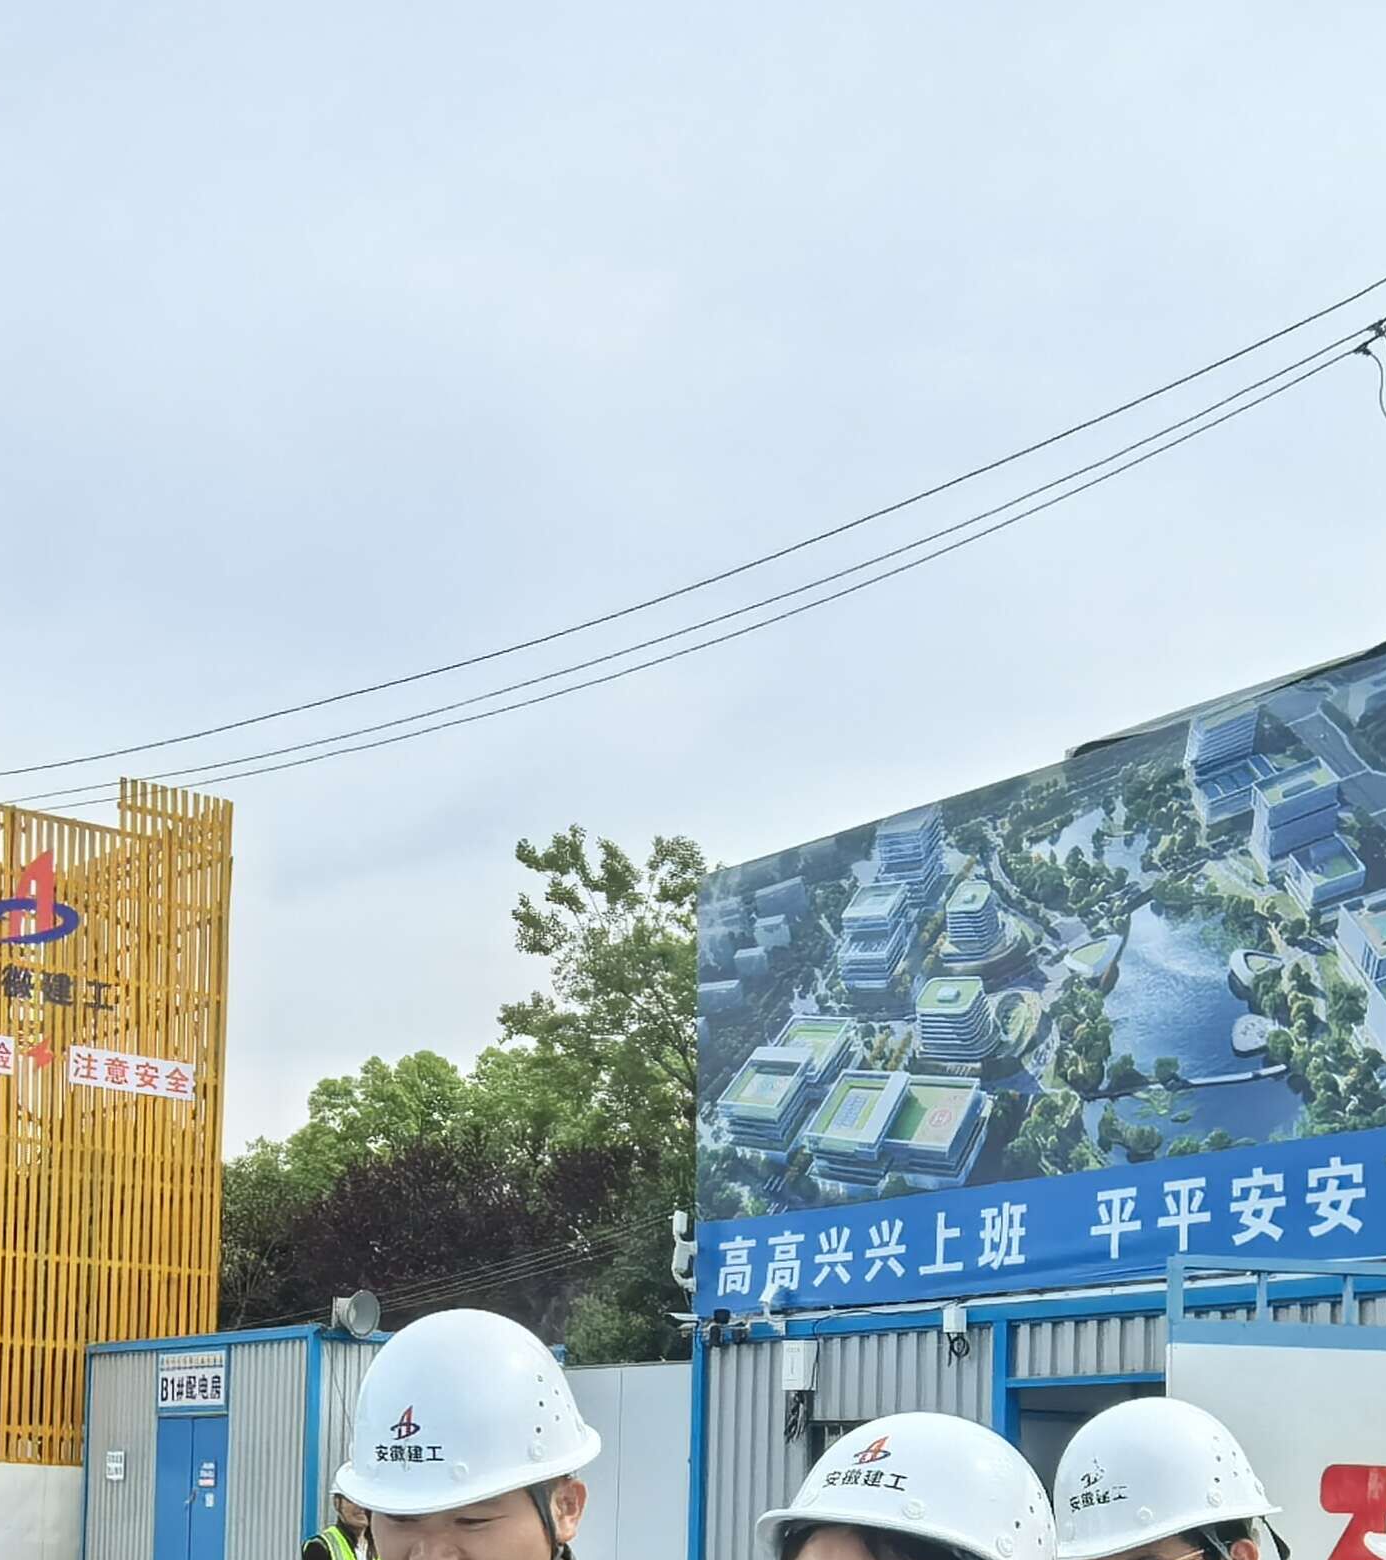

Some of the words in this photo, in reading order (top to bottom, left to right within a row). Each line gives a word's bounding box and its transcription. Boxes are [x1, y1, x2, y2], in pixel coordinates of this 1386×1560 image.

[72, 1051, 191, 1095] 注意安全
[716, 1202, 1028, 1297] 高高兴兴上班
[375, 1444, 445, 1463] 安徽建工
[821, 1469, 908, 1492] 安徽建工
